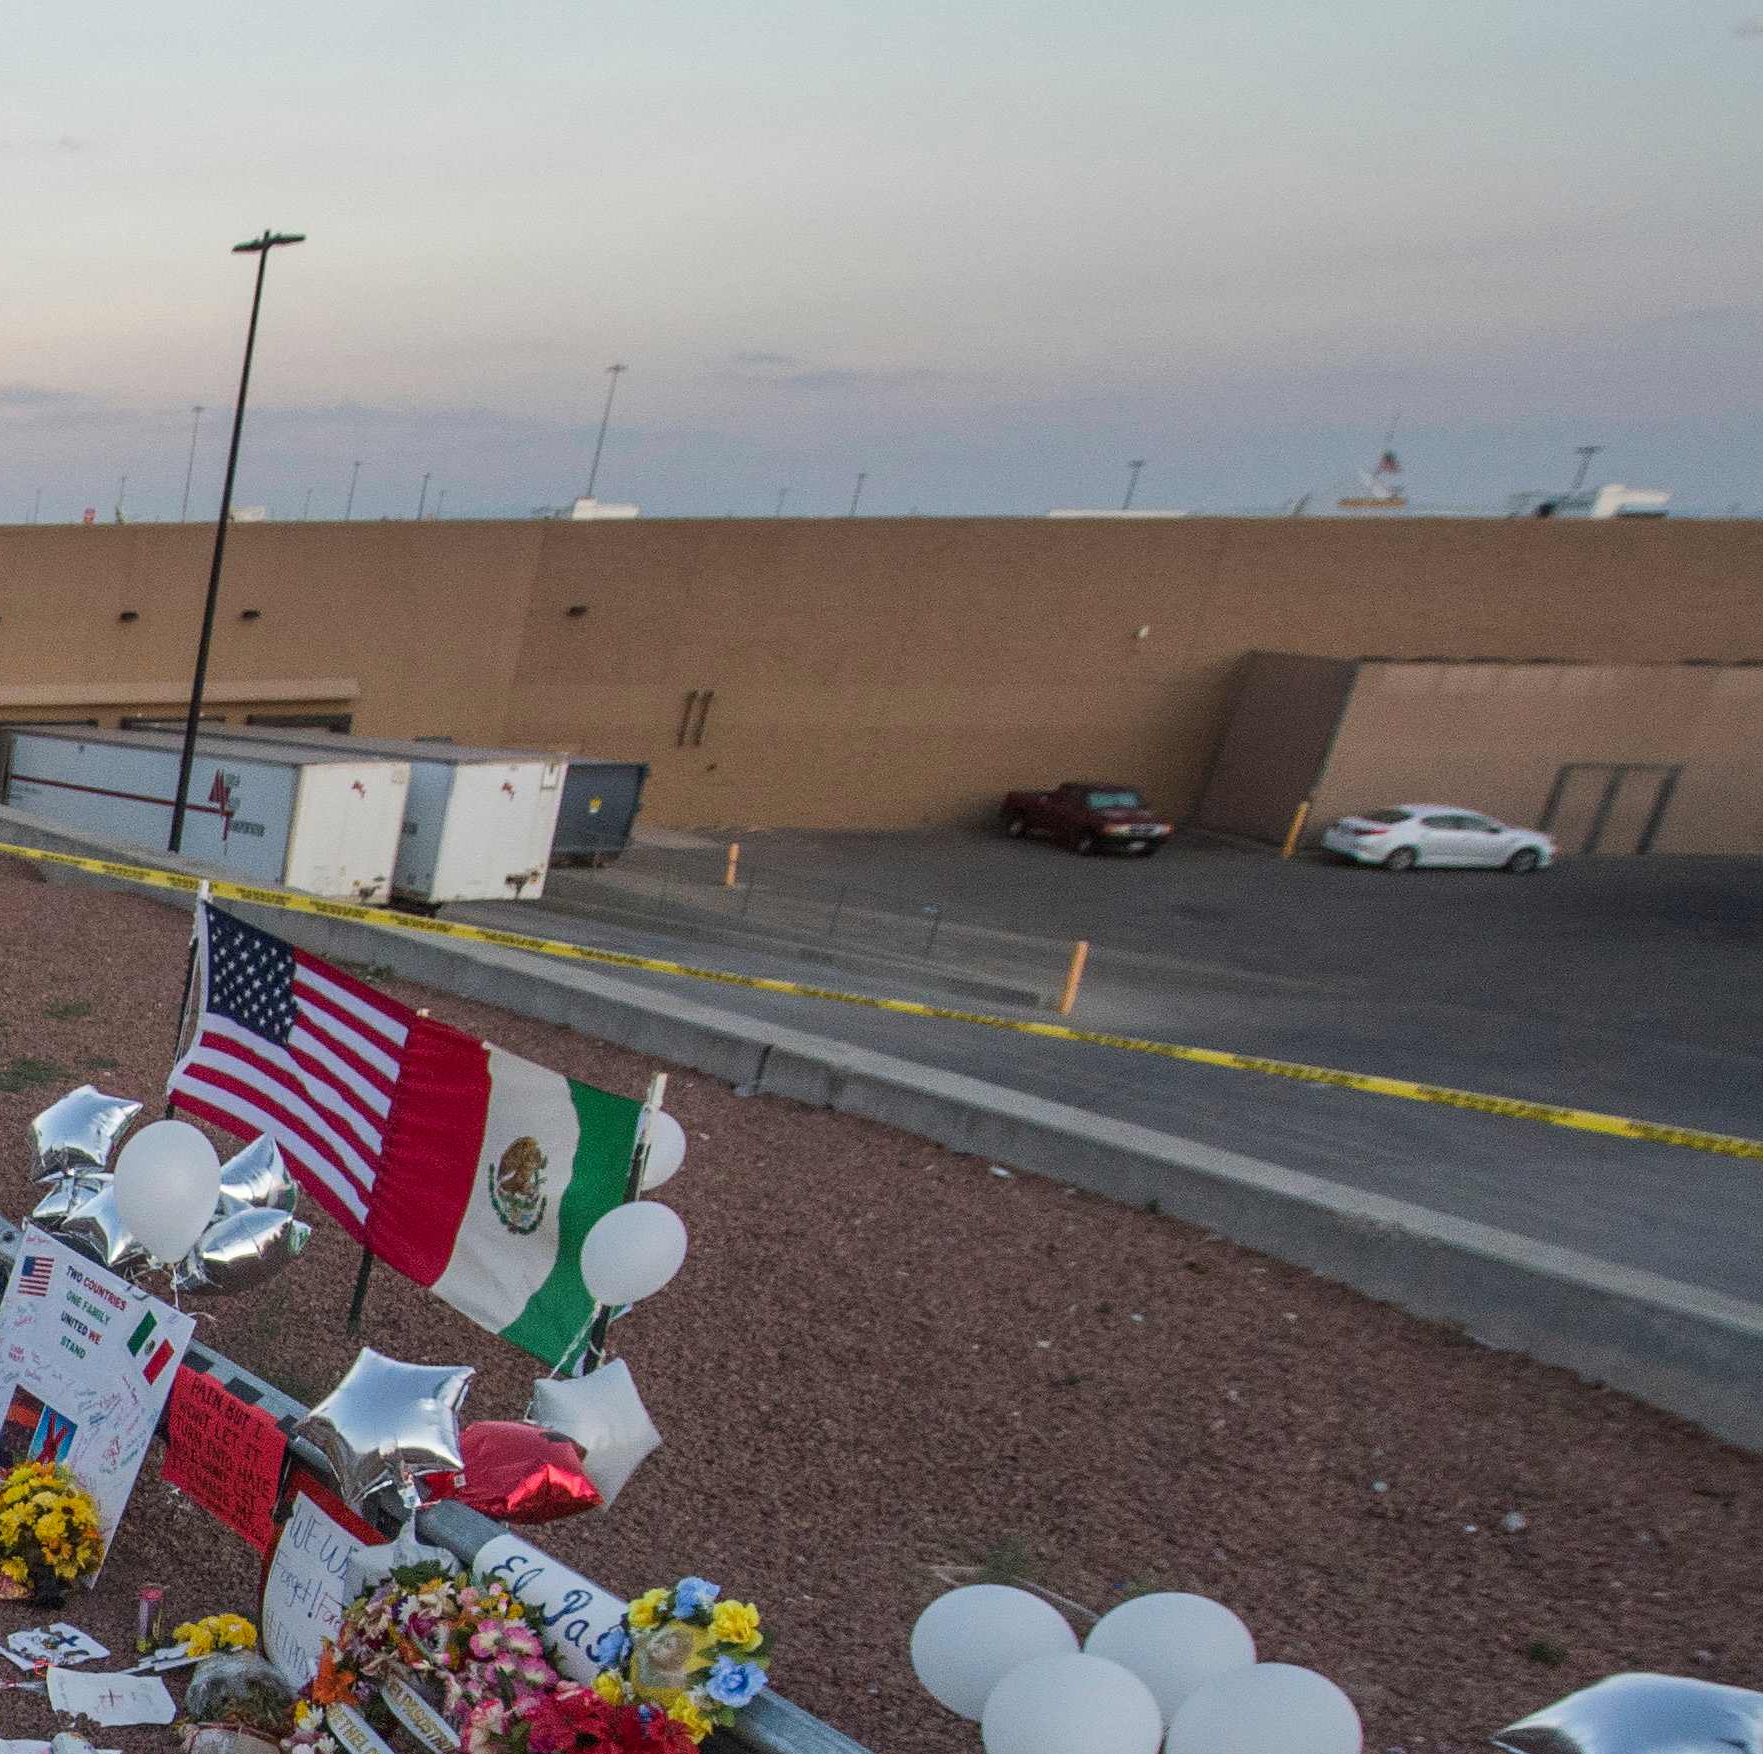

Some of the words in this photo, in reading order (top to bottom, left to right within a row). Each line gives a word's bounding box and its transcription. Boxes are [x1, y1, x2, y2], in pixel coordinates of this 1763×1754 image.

[66, 1265, 83, 1283] TWO
[83, 1276, 127, 1311] COUNTRIES
[66, 1290, 82, 1306] ONE
[82, 1301, 111, 1325] FAMILY
[60, 1311, 88, 1336] UNITED
[88, 1330, 102, 1345] WE
[60, 1335, 86, 1360] STAND
[224, 1402, 250, 1428] BUT
[211, 1422, 241, 1449] LET
[241, 1442, 262, 1464] IT
[234, 1464, 275, 1499] HATE
[289, 1506, 317, 1551] WE
[489, 1556, 545, 1600] El
